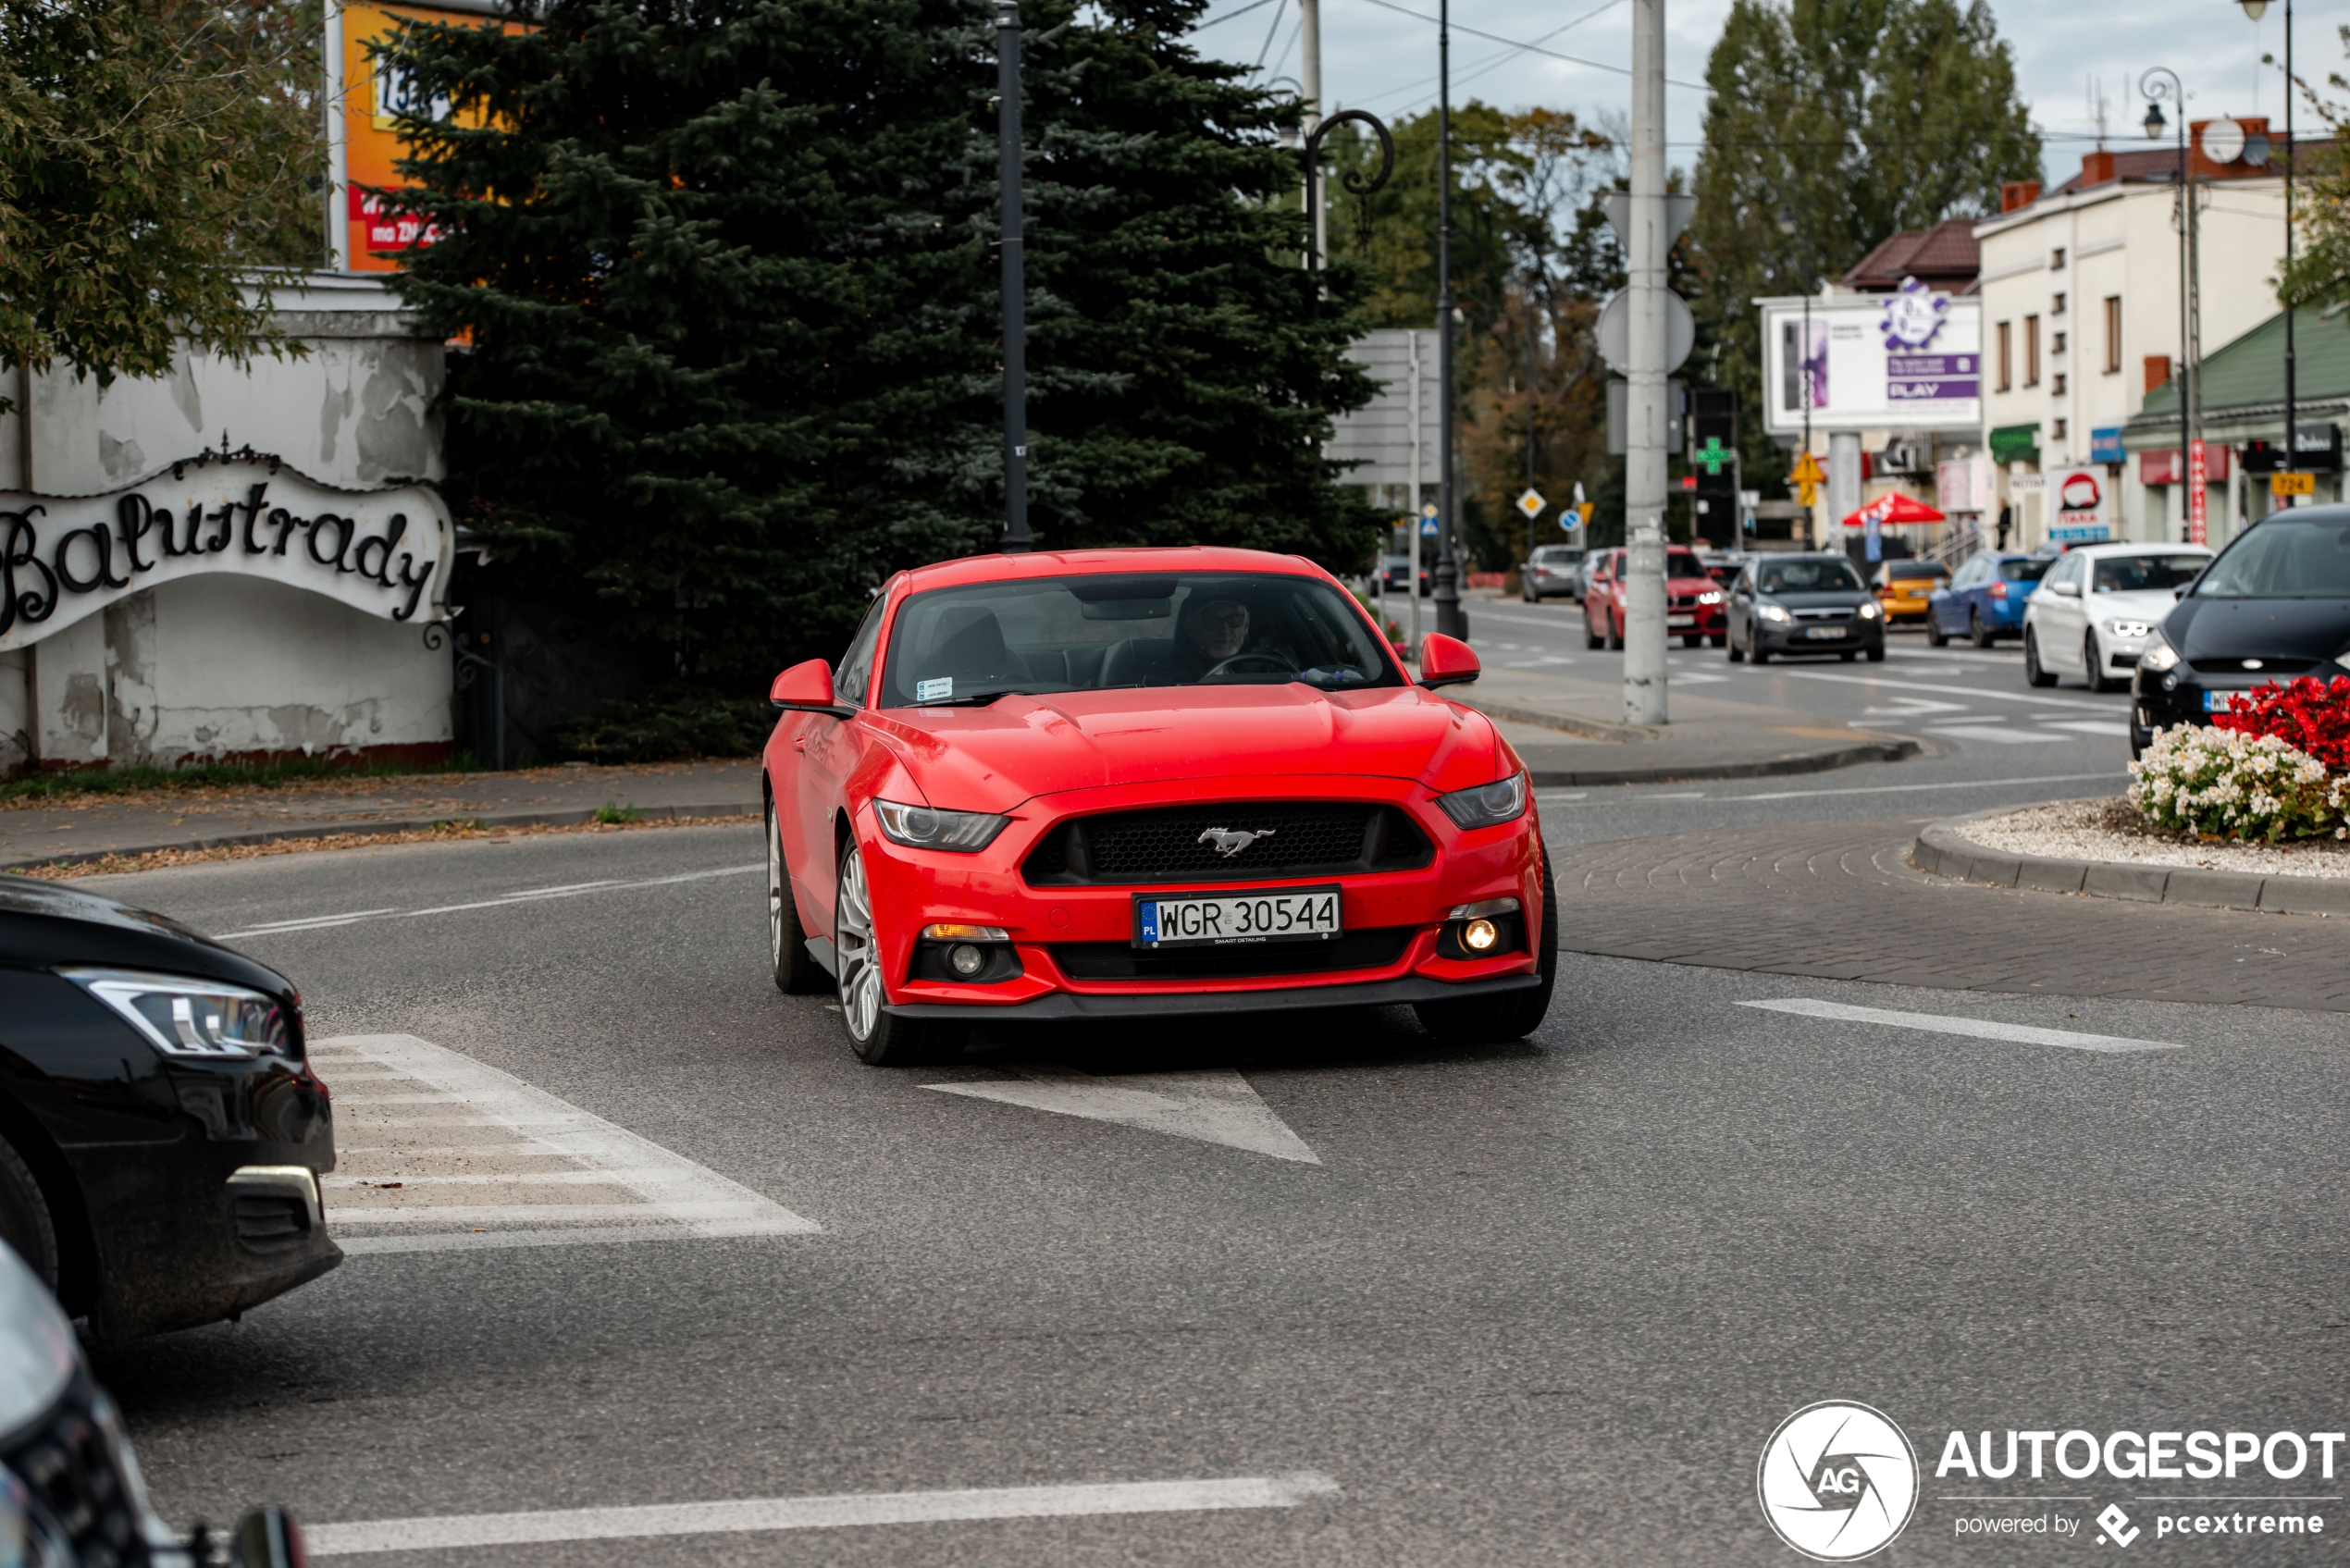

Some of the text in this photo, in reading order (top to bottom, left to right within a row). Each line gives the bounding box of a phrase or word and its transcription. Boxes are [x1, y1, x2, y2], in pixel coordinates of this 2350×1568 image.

[1888, 382, 1940, 398] PLAY
[2057, 511, 2098, 525] ITAKA
[0, 482, 435, 636] Balustrady
[1144, 895, 1334, 937] PL WGR 30544
